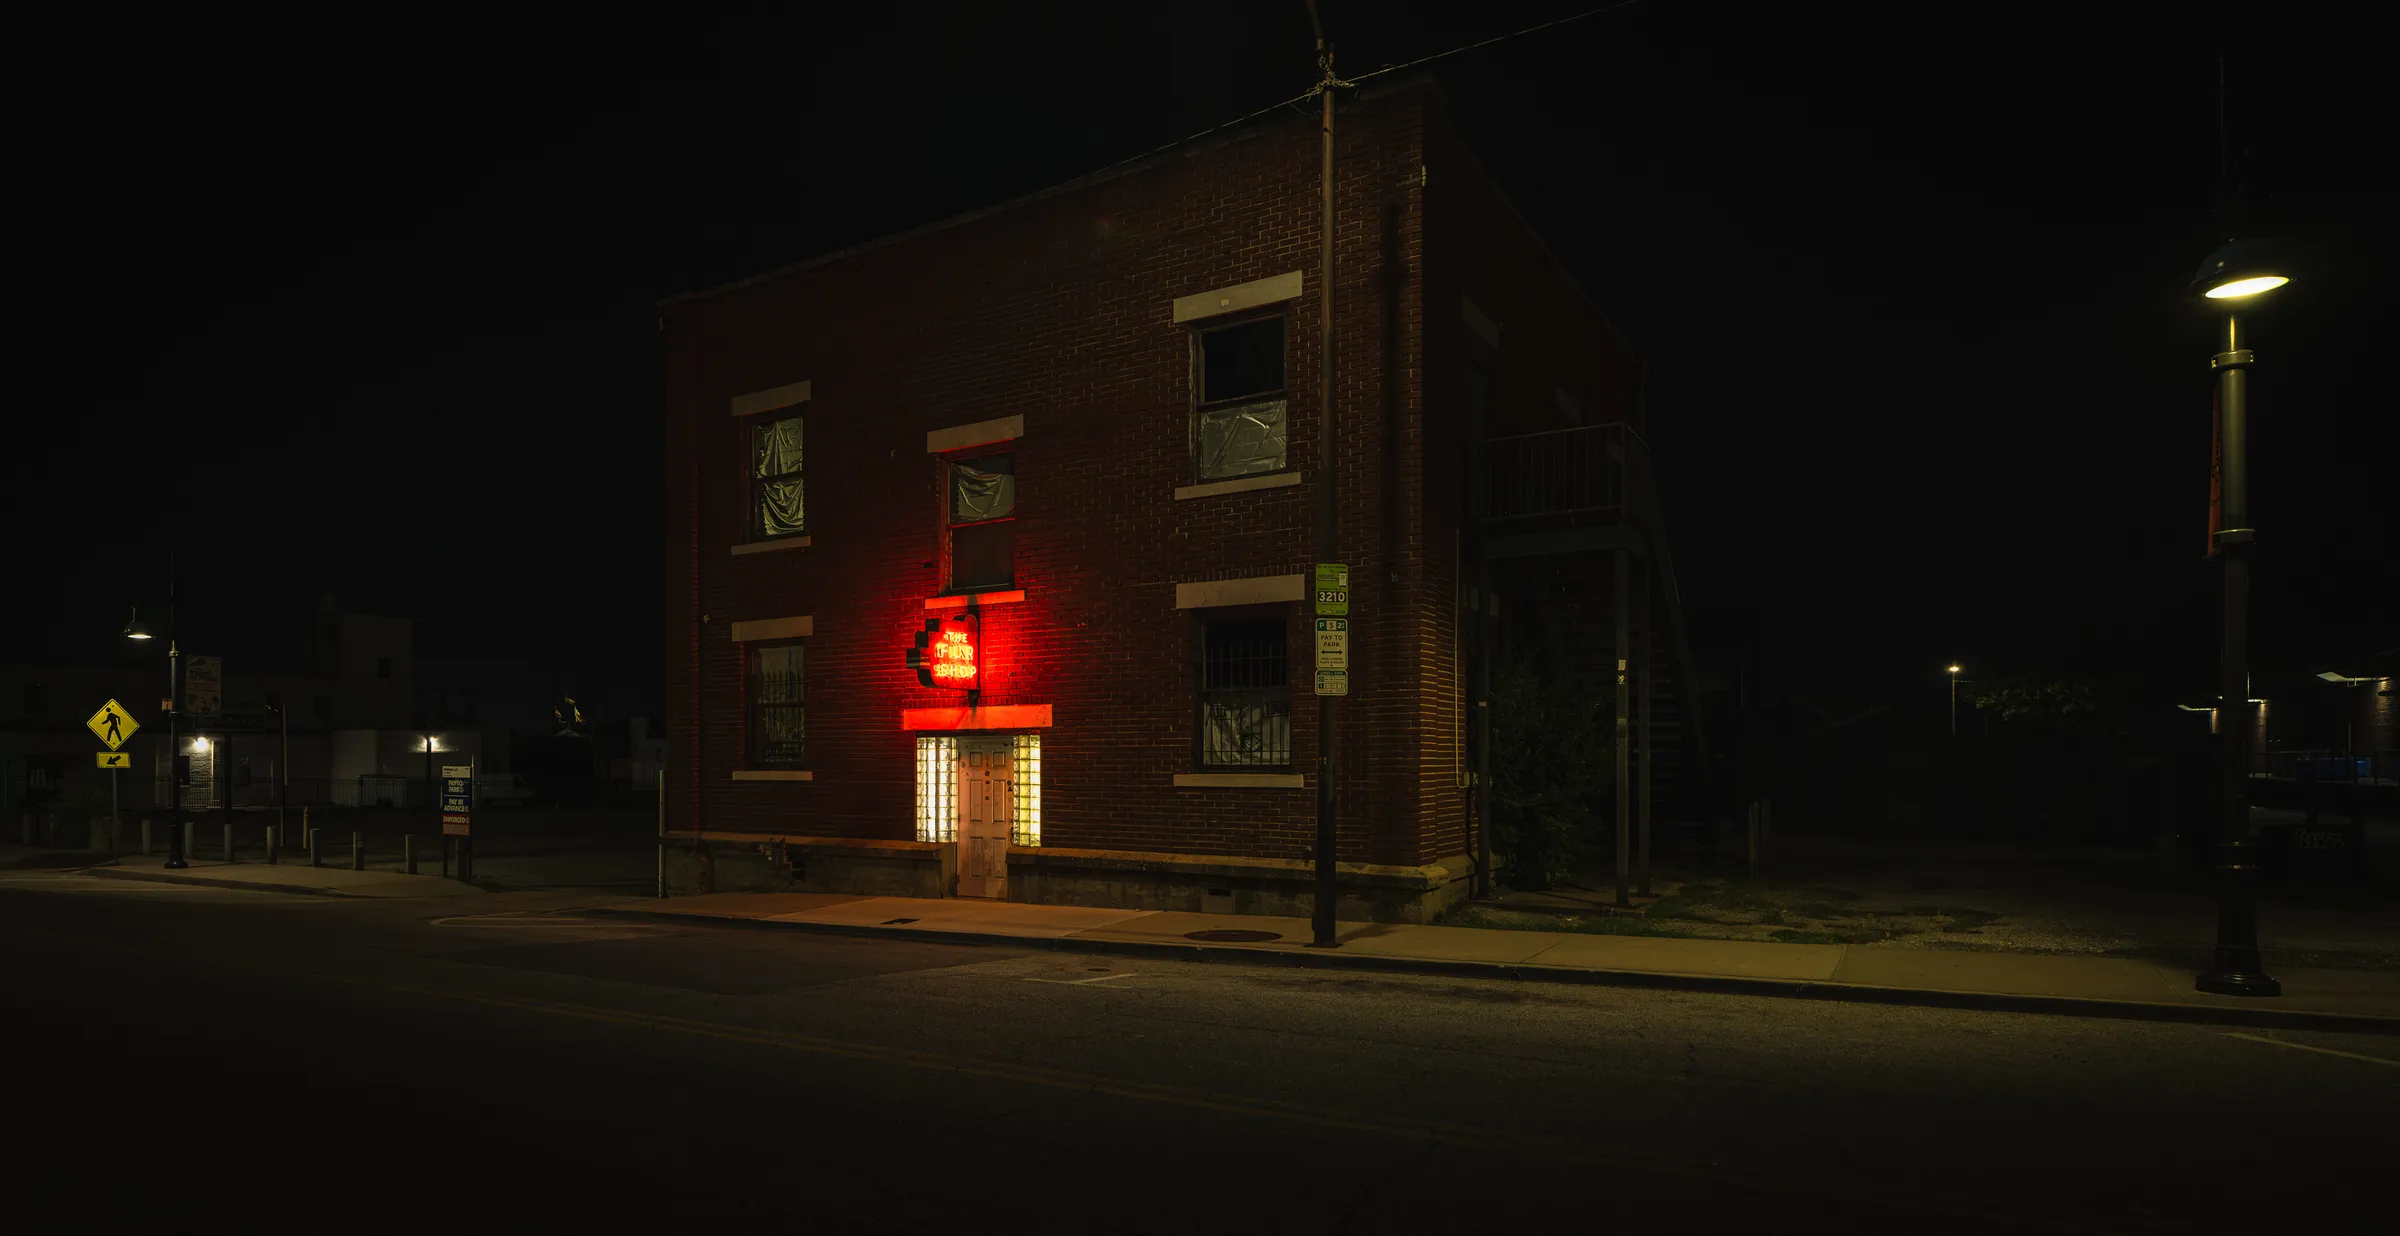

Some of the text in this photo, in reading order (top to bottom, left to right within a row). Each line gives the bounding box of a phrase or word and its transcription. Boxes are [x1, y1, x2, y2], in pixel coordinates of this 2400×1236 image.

[1319, 591, 1346, 602] 3210
[944, 631, 968, 643] THE
[935, 643, 974, 661] FUR
[933, 663, 977, 679] SHOP
[443, 815, 465, 824] ENFORCED
